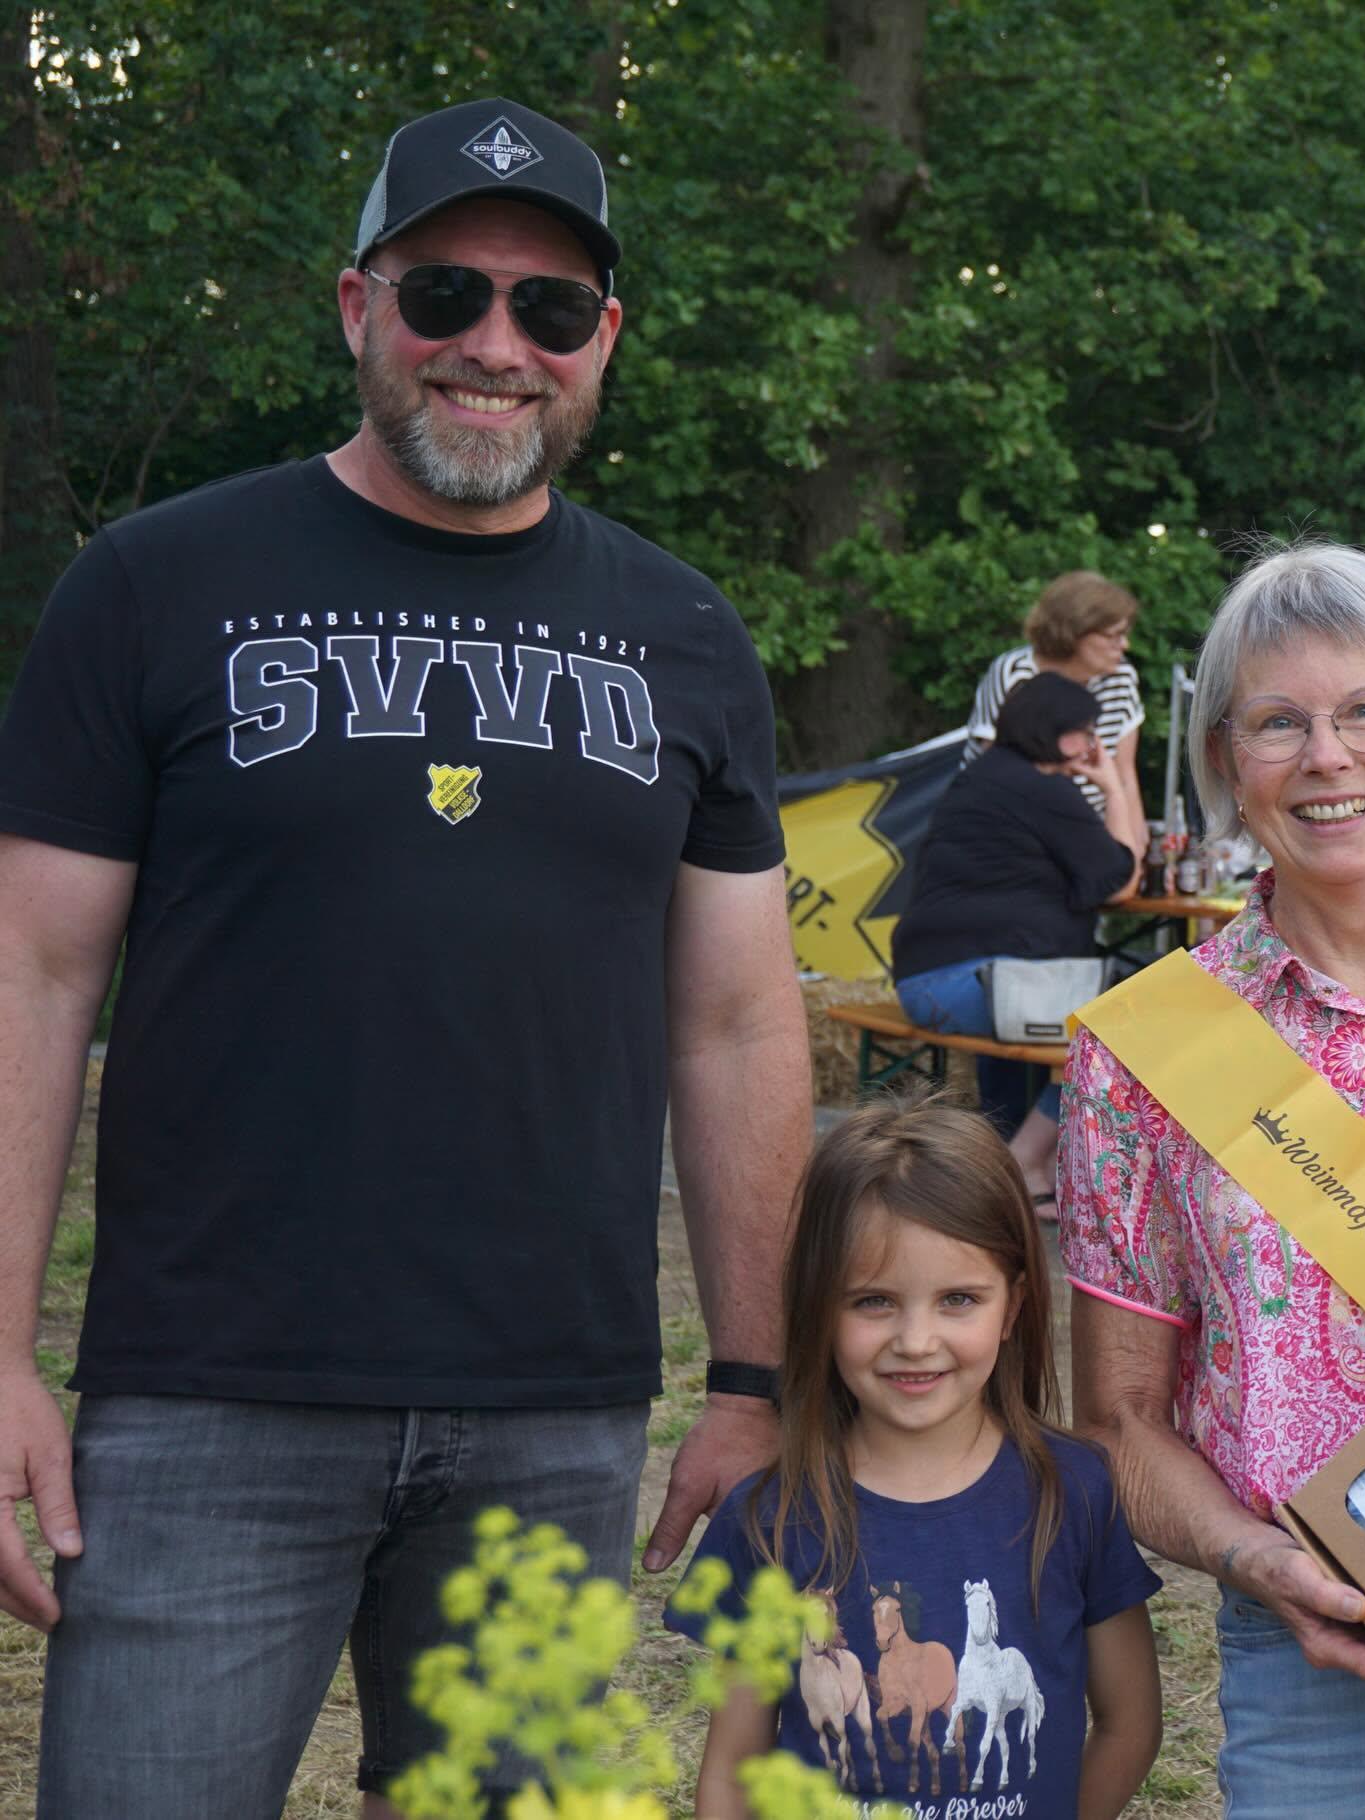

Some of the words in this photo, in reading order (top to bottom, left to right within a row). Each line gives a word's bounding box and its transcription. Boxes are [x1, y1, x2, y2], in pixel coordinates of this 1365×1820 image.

[473, 143, 532, 157] soulbuddy
[225, 610, 487, 635] ESTABLISHED
[518, 620, 550, 640] IN
[578, 631, 648, 661] 1921
[228, 635, 661, 785] SVVD
[784, 866, 836, 931] RT-
[945, 1792, 1028, 1820] forever
